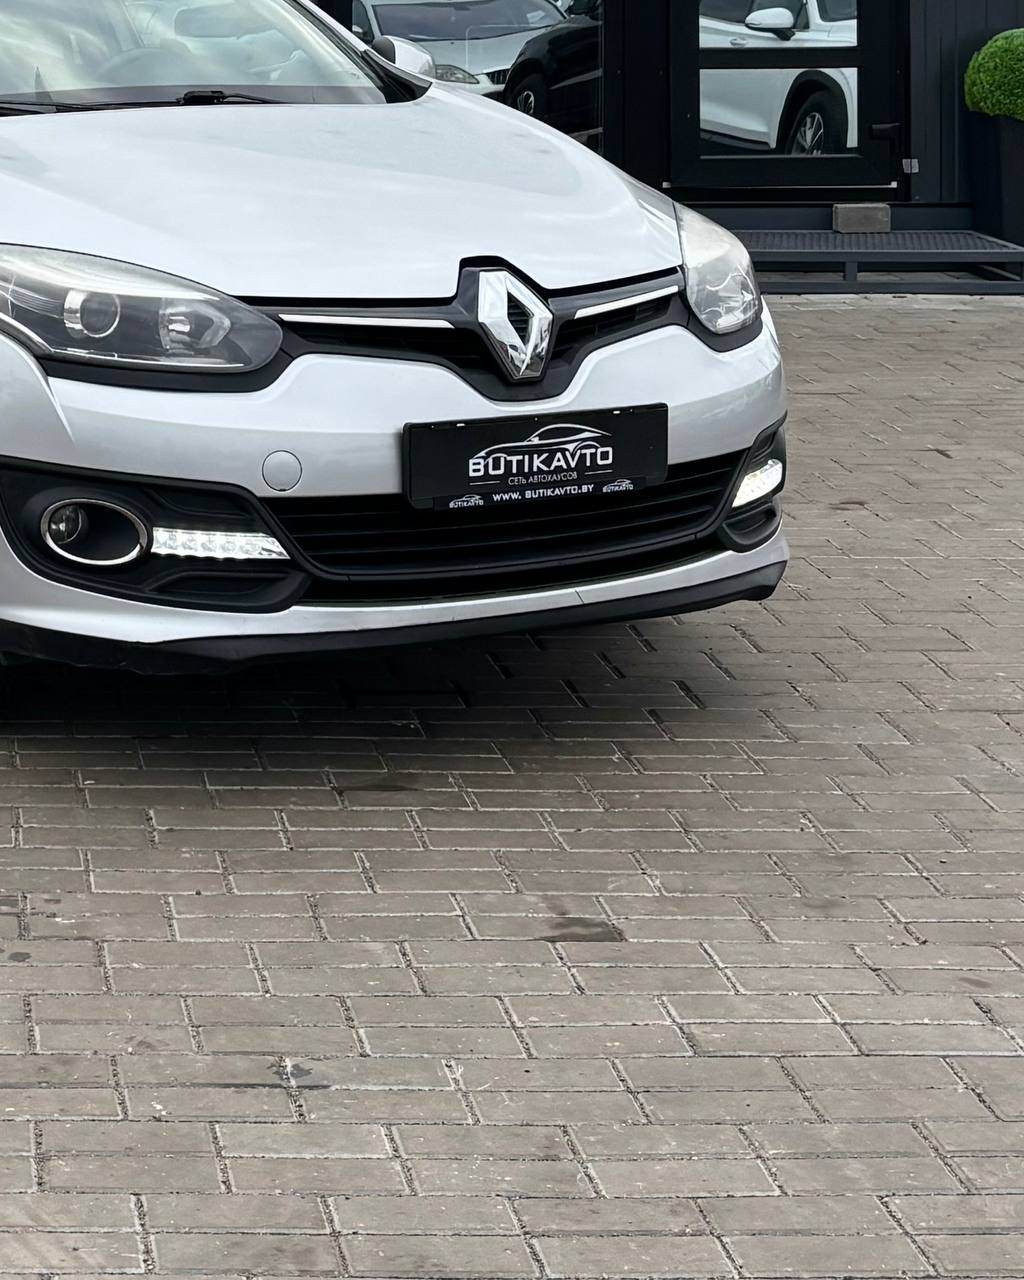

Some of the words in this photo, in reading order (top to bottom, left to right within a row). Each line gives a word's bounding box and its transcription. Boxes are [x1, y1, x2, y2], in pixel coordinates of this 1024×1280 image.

[469, 447, 613, 477] BUTIKAVTO
[508, 476, 527, 485] СЕТЬ
[528, 472, 578, 484] АВТОХАУСОВ
[492, 492, 522, 502] WWW.
[525, 484, 594, 499] BUTIKAVTO.BY
